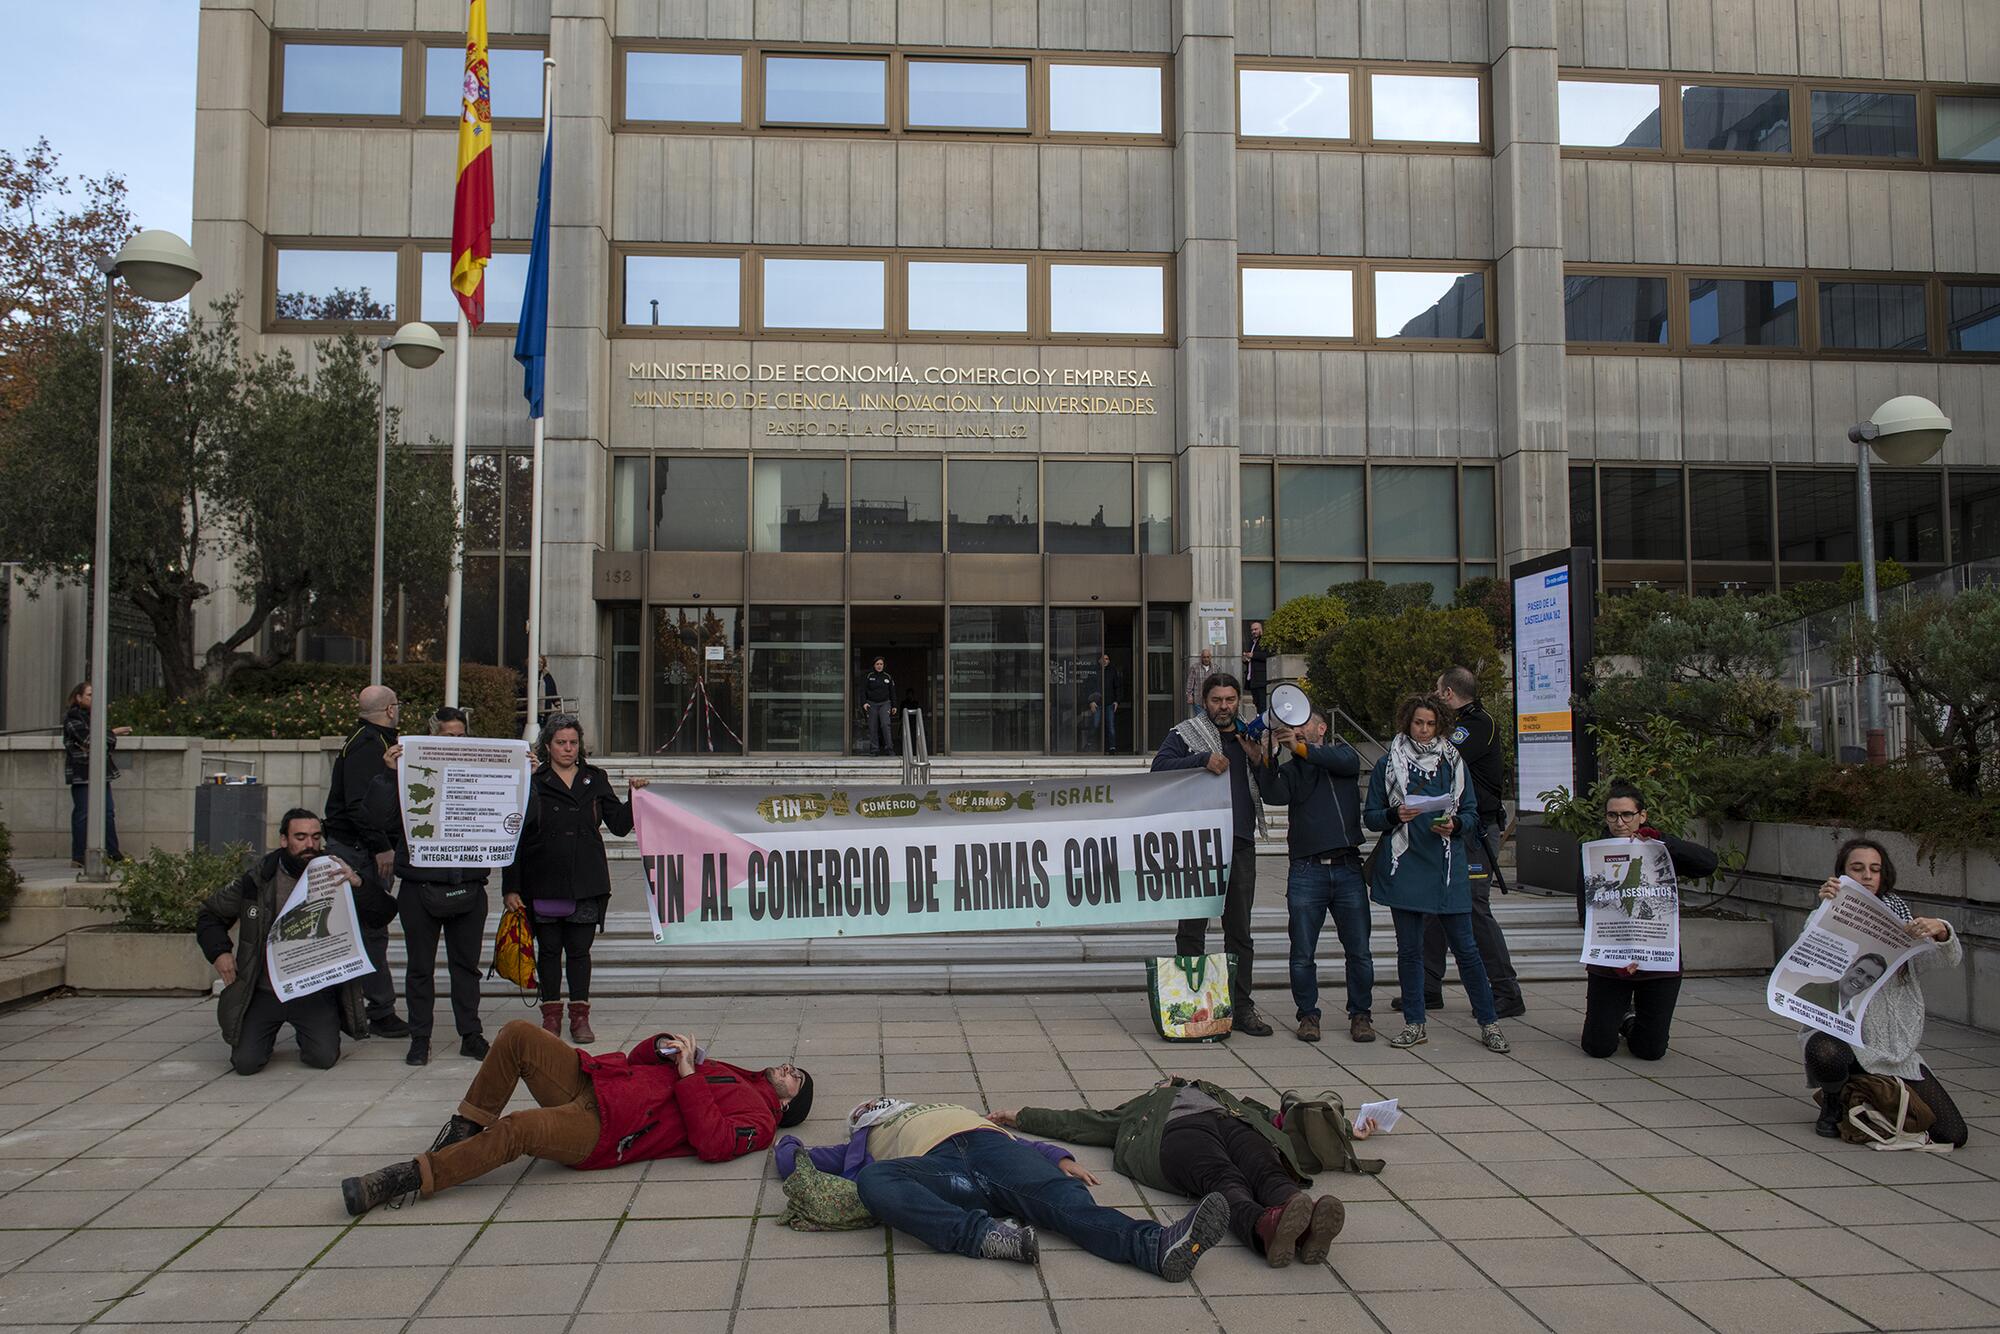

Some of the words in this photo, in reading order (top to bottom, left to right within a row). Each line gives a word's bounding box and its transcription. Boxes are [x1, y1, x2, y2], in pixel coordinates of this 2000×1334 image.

[628, 362, 750, 380] MINISTERIO
[758, 364, 786, 381] DE
[793, 362, 919, 385] ECONOMÍA,
[924, 367, 1040, 385] COMERCIO
[1043, 369, 1057, 384] Y
[1064, 369, 1153, 387] EMPRESA
[632, 391, 737, 408] MINISTERIO
[743, 392, 768, 409] DE
[775, 392, 855, 412] CIENCIA,
[861, 391, 981, 411] INNOVACIÓN
[991, 396, 1004, 410] Y
[1012, 396, 1155, 415] UNIVERSIDADES
[767, 422, 820, 436] PASEO
[827, 423, 848, 436] DE
[854, 424, 873, 437] LA
[1002, 424, 1026, 438] 162
[1527, 600, 1542, 611] PASEO
[1543, 598, 1549, 608] DE
[1550, 597, 1556, 607] LA
[1524, 613, 1553, 625] CASTELLANA
[771, 799, 801, 818] FIN
[804, 800, 817, 810] AL
[862, 799, 917, 813] COMERCIO
[956, 797, 967, 806] DE
[971, 796, 1007, 807] ARMAS
[1051, 784, 1115, 807] ISRAEL
[489, 844, 515, 853] EMBARGO
[421, 854, 453, 862] INTEGRAL
[459, 854, 483, 862] ARMAS
[643, 854, 685, 923] FIN
[701, 853, 733, 922] AL
[748, 846, 891, 921] COMERCIO
[905, 845, 940, 914] DE
[954, 839, 1051, 912] ARMAS
[1064, 836, 1121, 907] CON
[1133, 828, 1228, 902] ISRAEL
[1612, 864, 1622, 879] 7
[299, 979, 322, 989] INTEGRAL
[1788, 1005, 1813, 1019] INTEGRAL
[1833, 1017, 1856, 1031] EMBARGO
